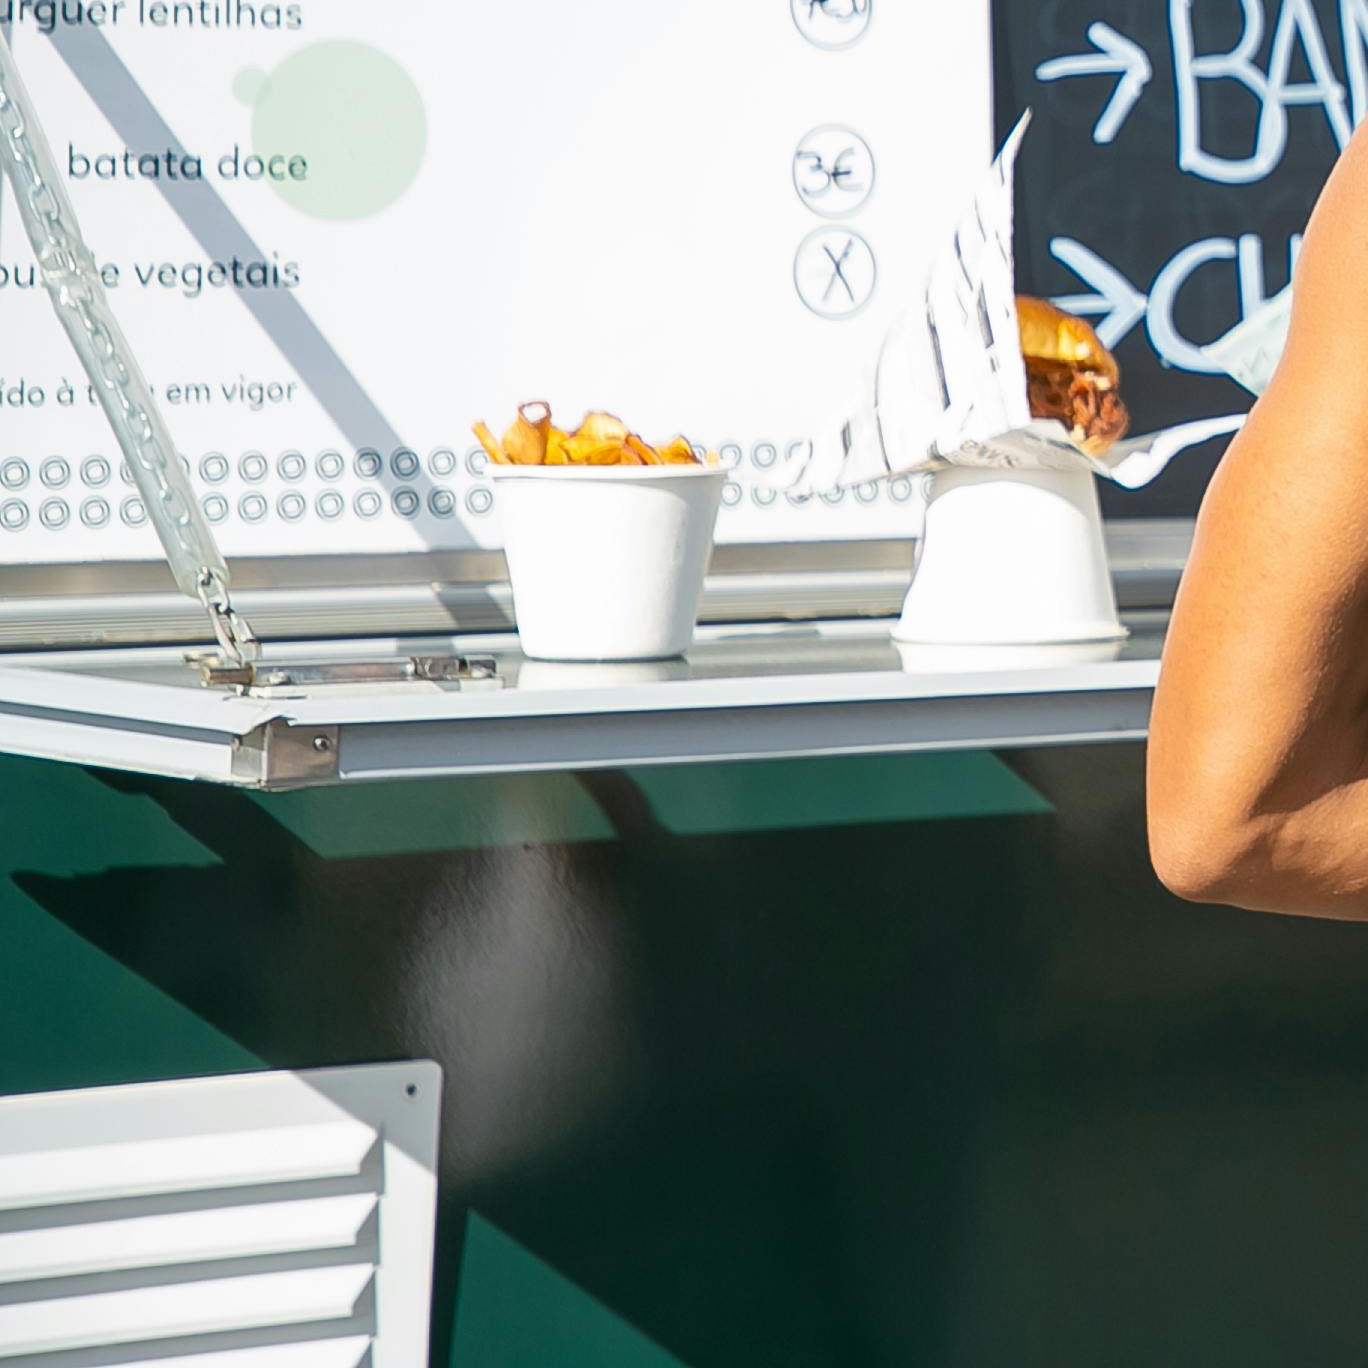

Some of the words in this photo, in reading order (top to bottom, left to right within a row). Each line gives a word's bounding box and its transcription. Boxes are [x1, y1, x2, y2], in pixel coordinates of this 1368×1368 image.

[68, 141, 203, 181] batata
[217, 143, 308, 181] doce
[135, 251, 301, 298] vegetais
[57, 377, 74, 406] à
[166, 383, 211, 405] em
[221, 374, 297, 411] vigor
